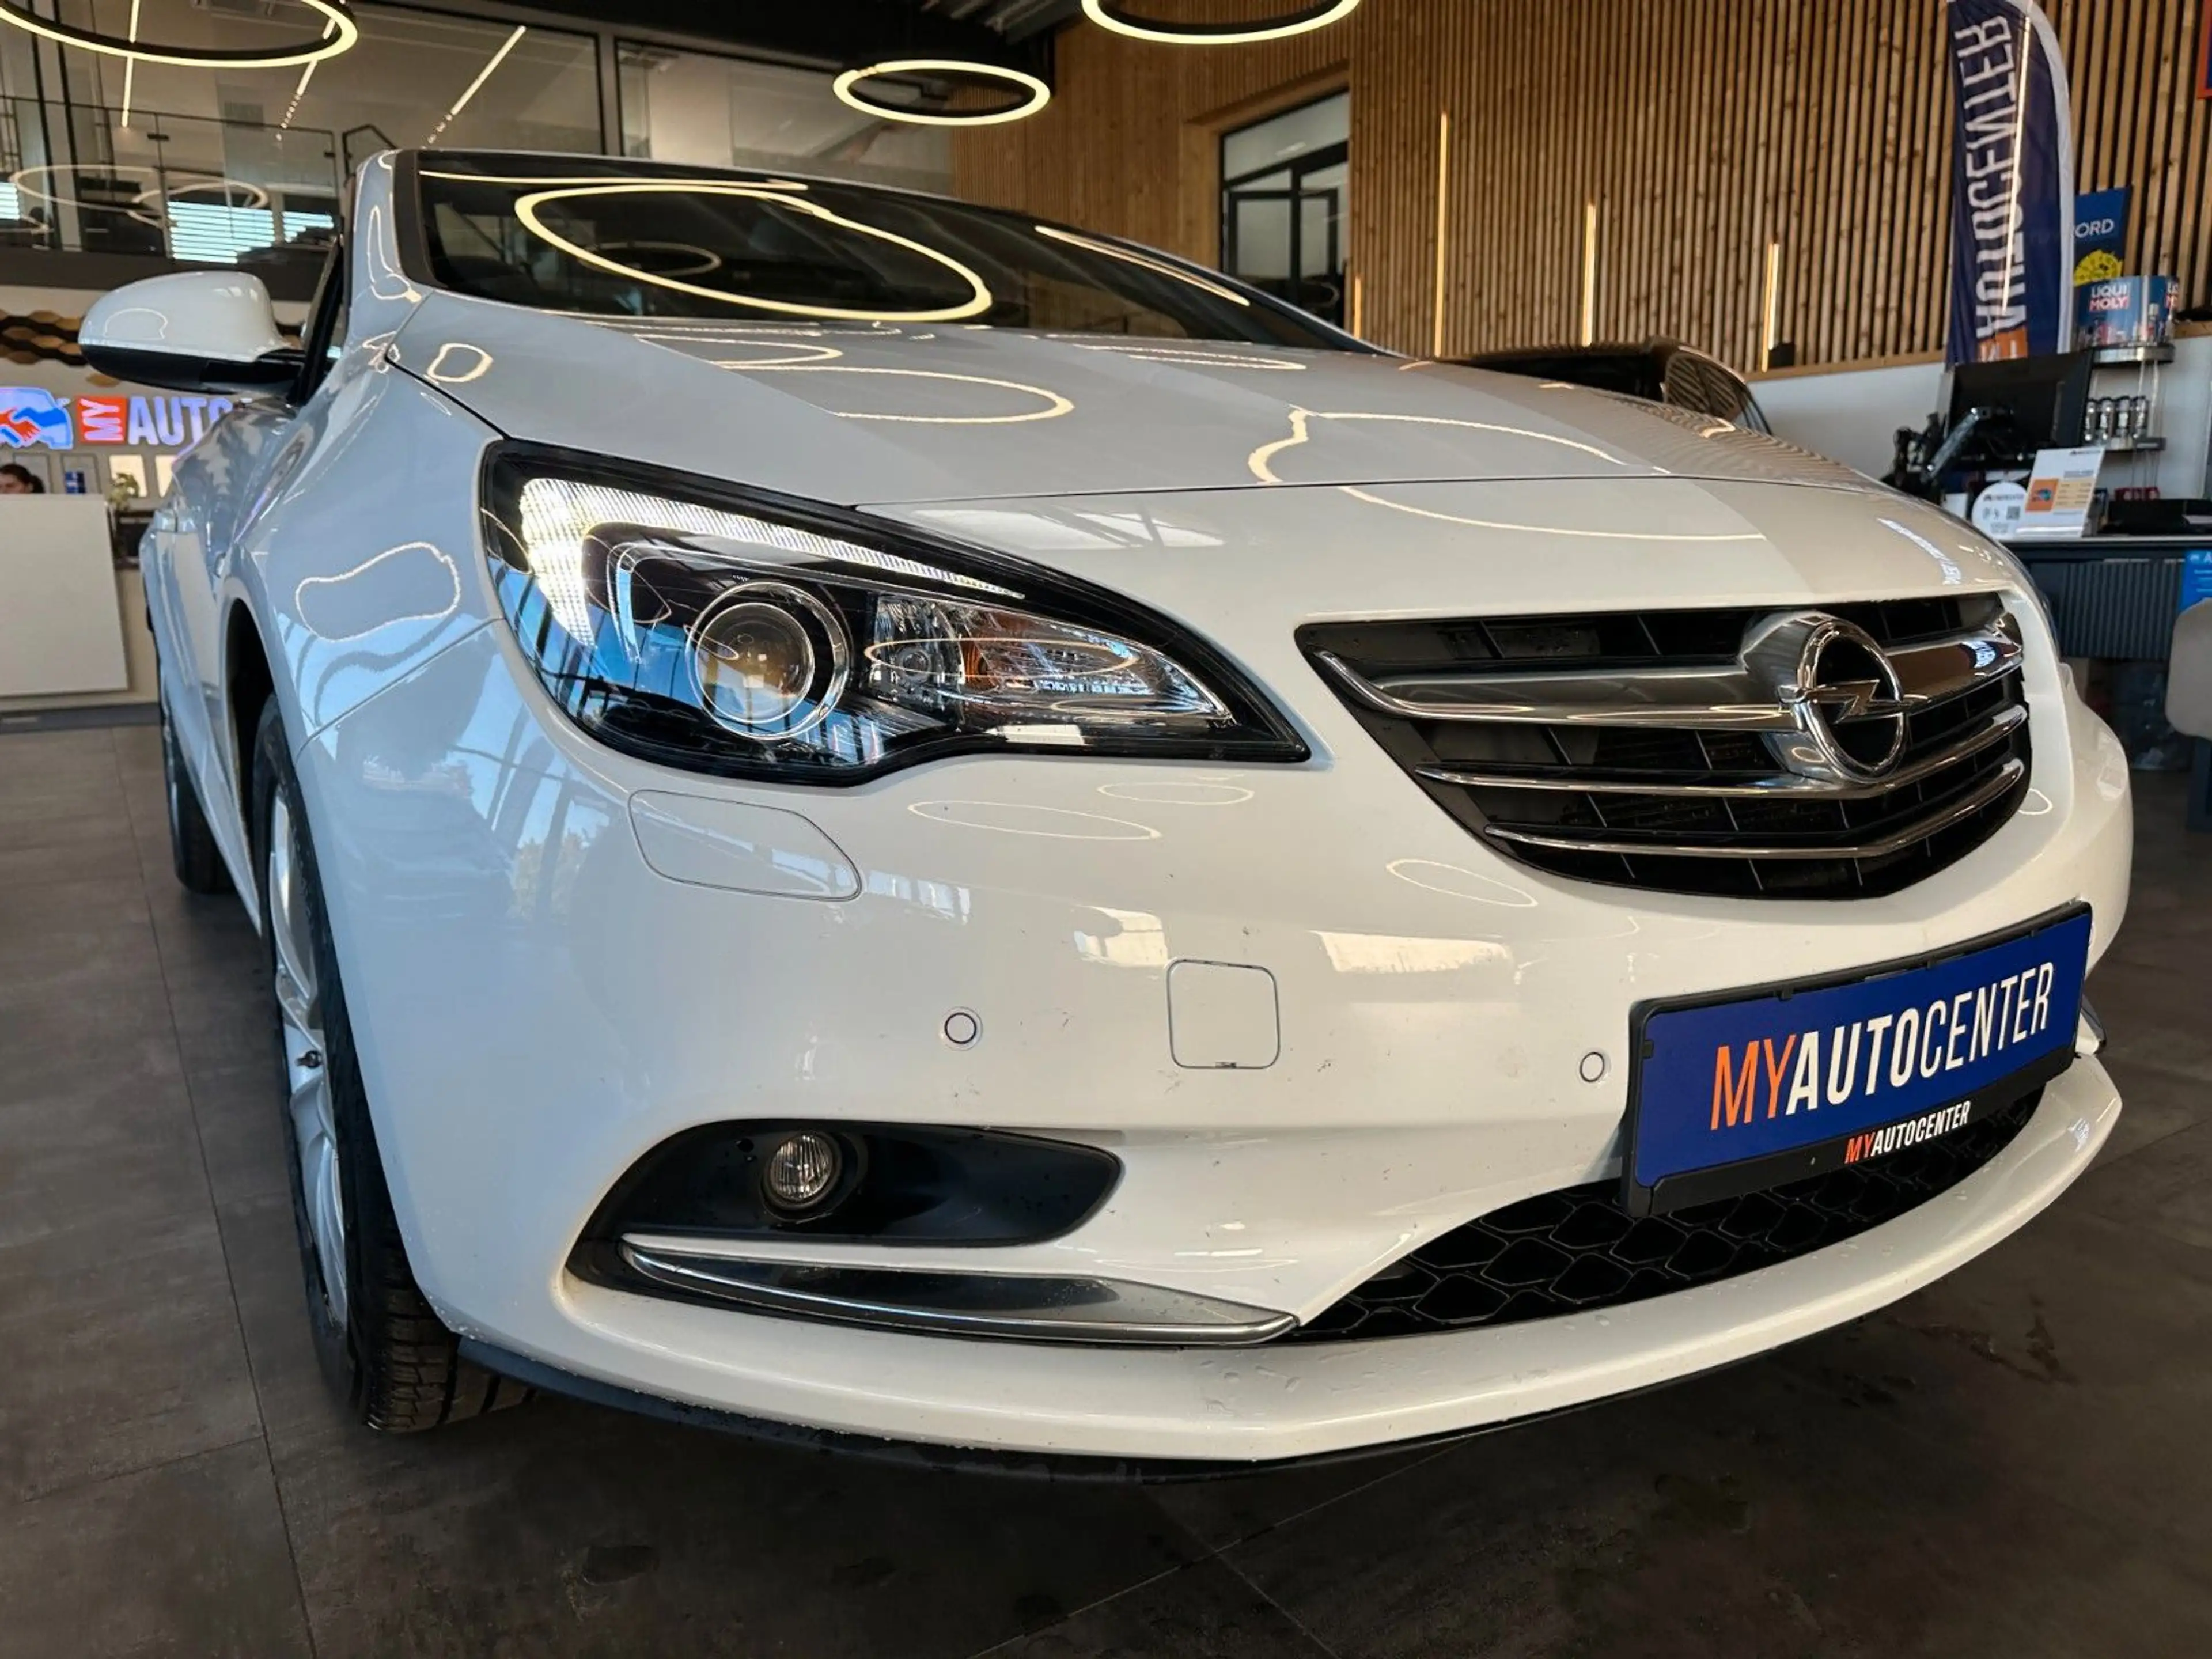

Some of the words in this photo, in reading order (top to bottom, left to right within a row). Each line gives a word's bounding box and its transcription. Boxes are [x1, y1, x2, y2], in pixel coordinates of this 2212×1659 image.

[2089, 296, 2129, 311] MOLY
[79, 398, 124, 441] MY
[1710, 961, 2054, 1131] MYAUTOCENTER
[1844, 1100, 1971, 1164] MYAUTOCENTER
